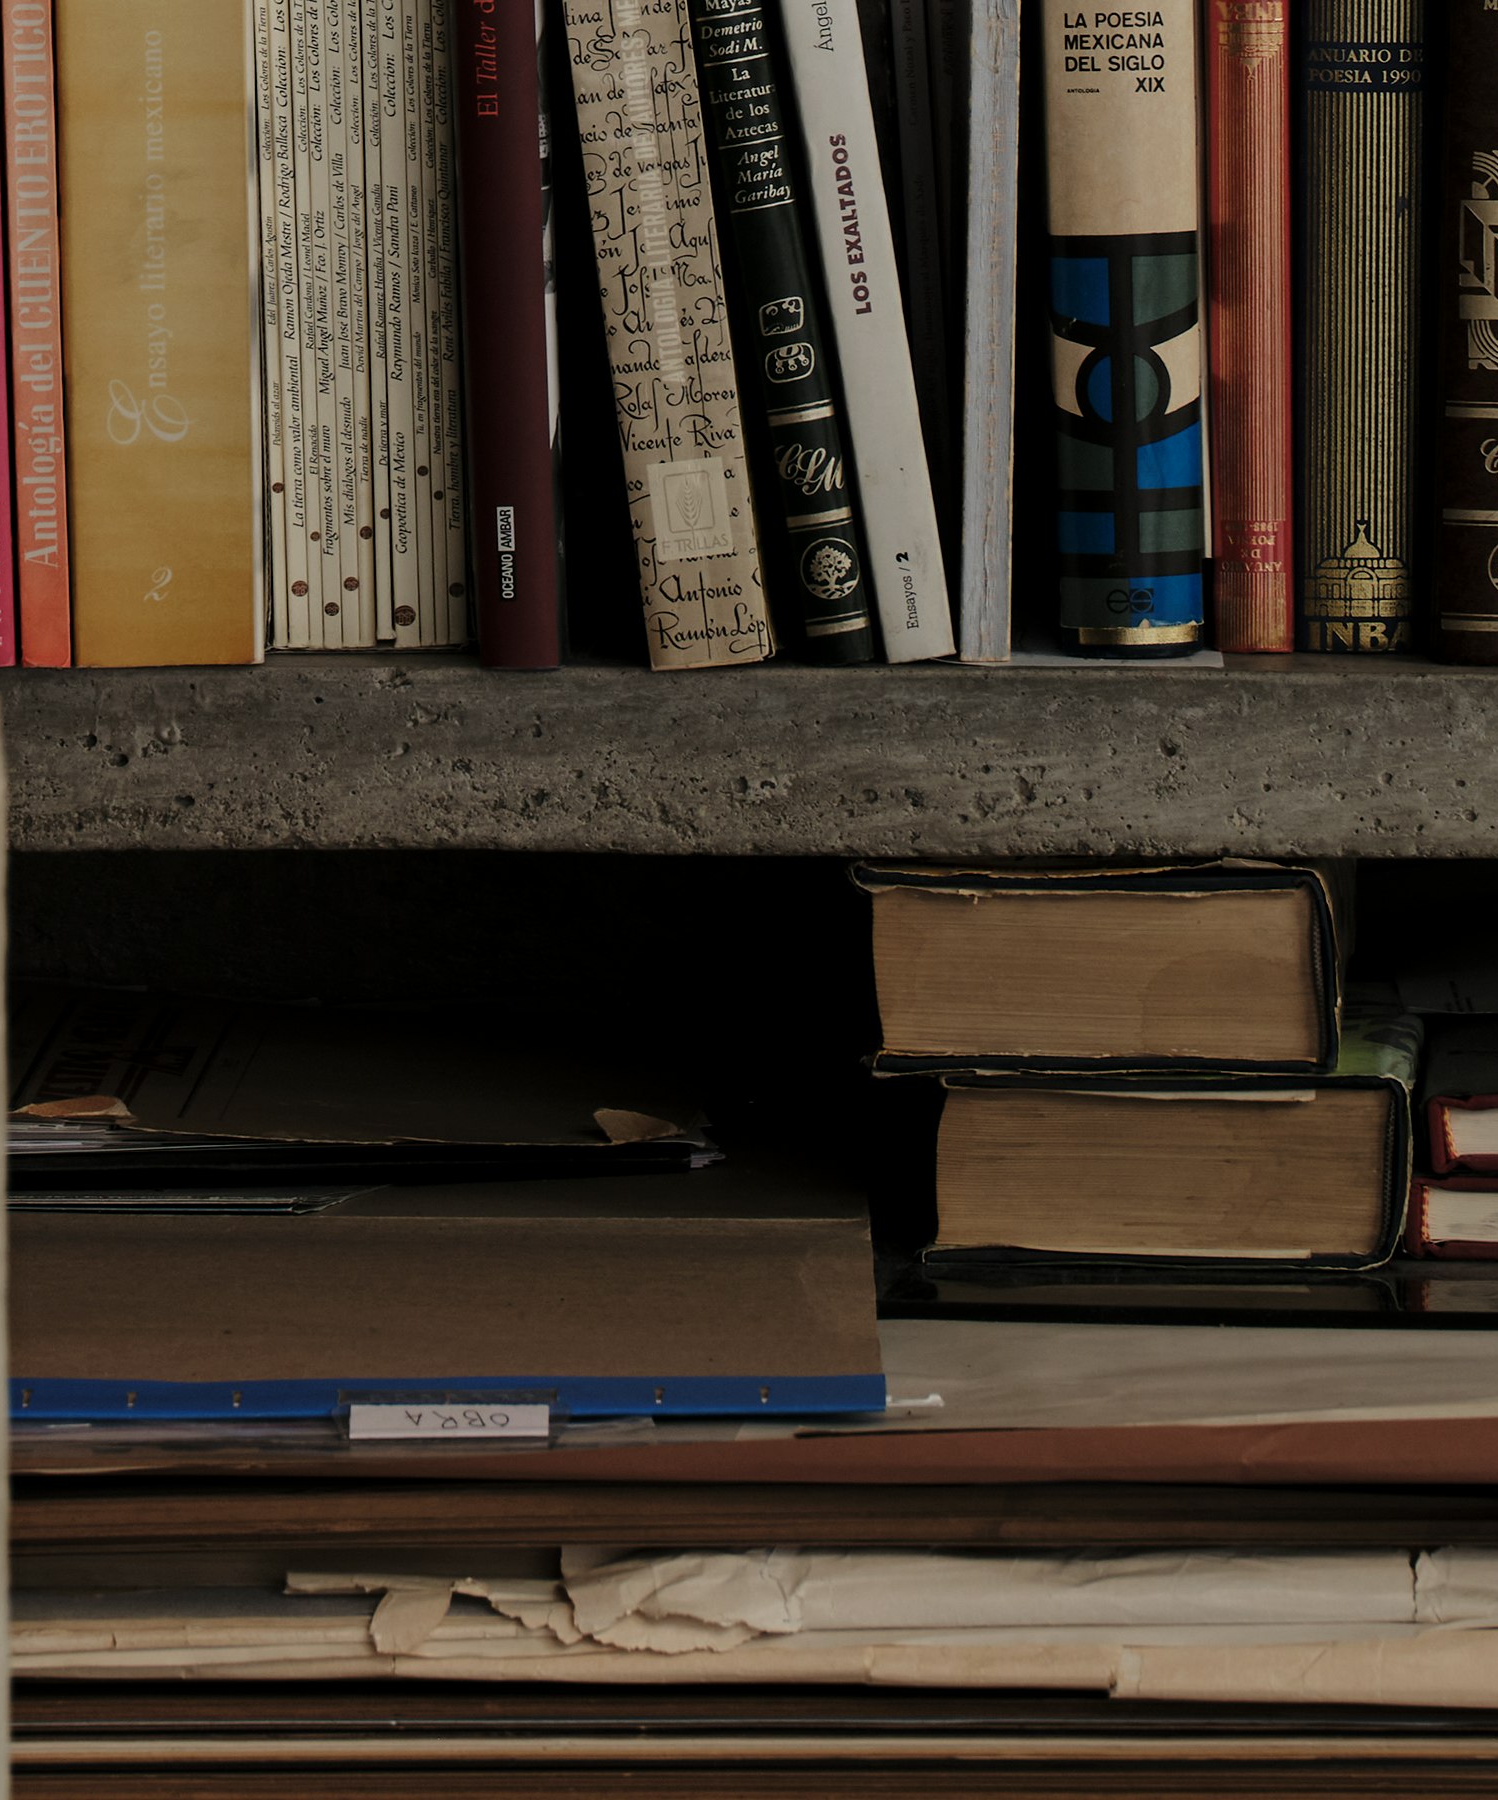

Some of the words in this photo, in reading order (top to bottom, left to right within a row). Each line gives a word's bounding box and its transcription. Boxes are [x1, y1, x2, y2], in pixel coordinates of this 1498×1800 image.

[811, 0, 833, 53] Ángel
[1064, 13, 1087, 28] LA
[1095, 12, 1164, 28] POESIA
[474, 22, 497, 85] Taller
[1064, 33, 1164, 50] MEXICANA
[1065, 56, 1101, 71] DEL
[1108, 55, 1165, 71] SIGLO
[1135, 77, 1165, 92] XIX
[476, 93, 498, 118] El
[829, 133, 865, 265] EXALTADOS
[850, 271, 872, 314] LOS
[499, 509, 512, 548] AMBAR
[501, 554, 514, 599] OCEANO
